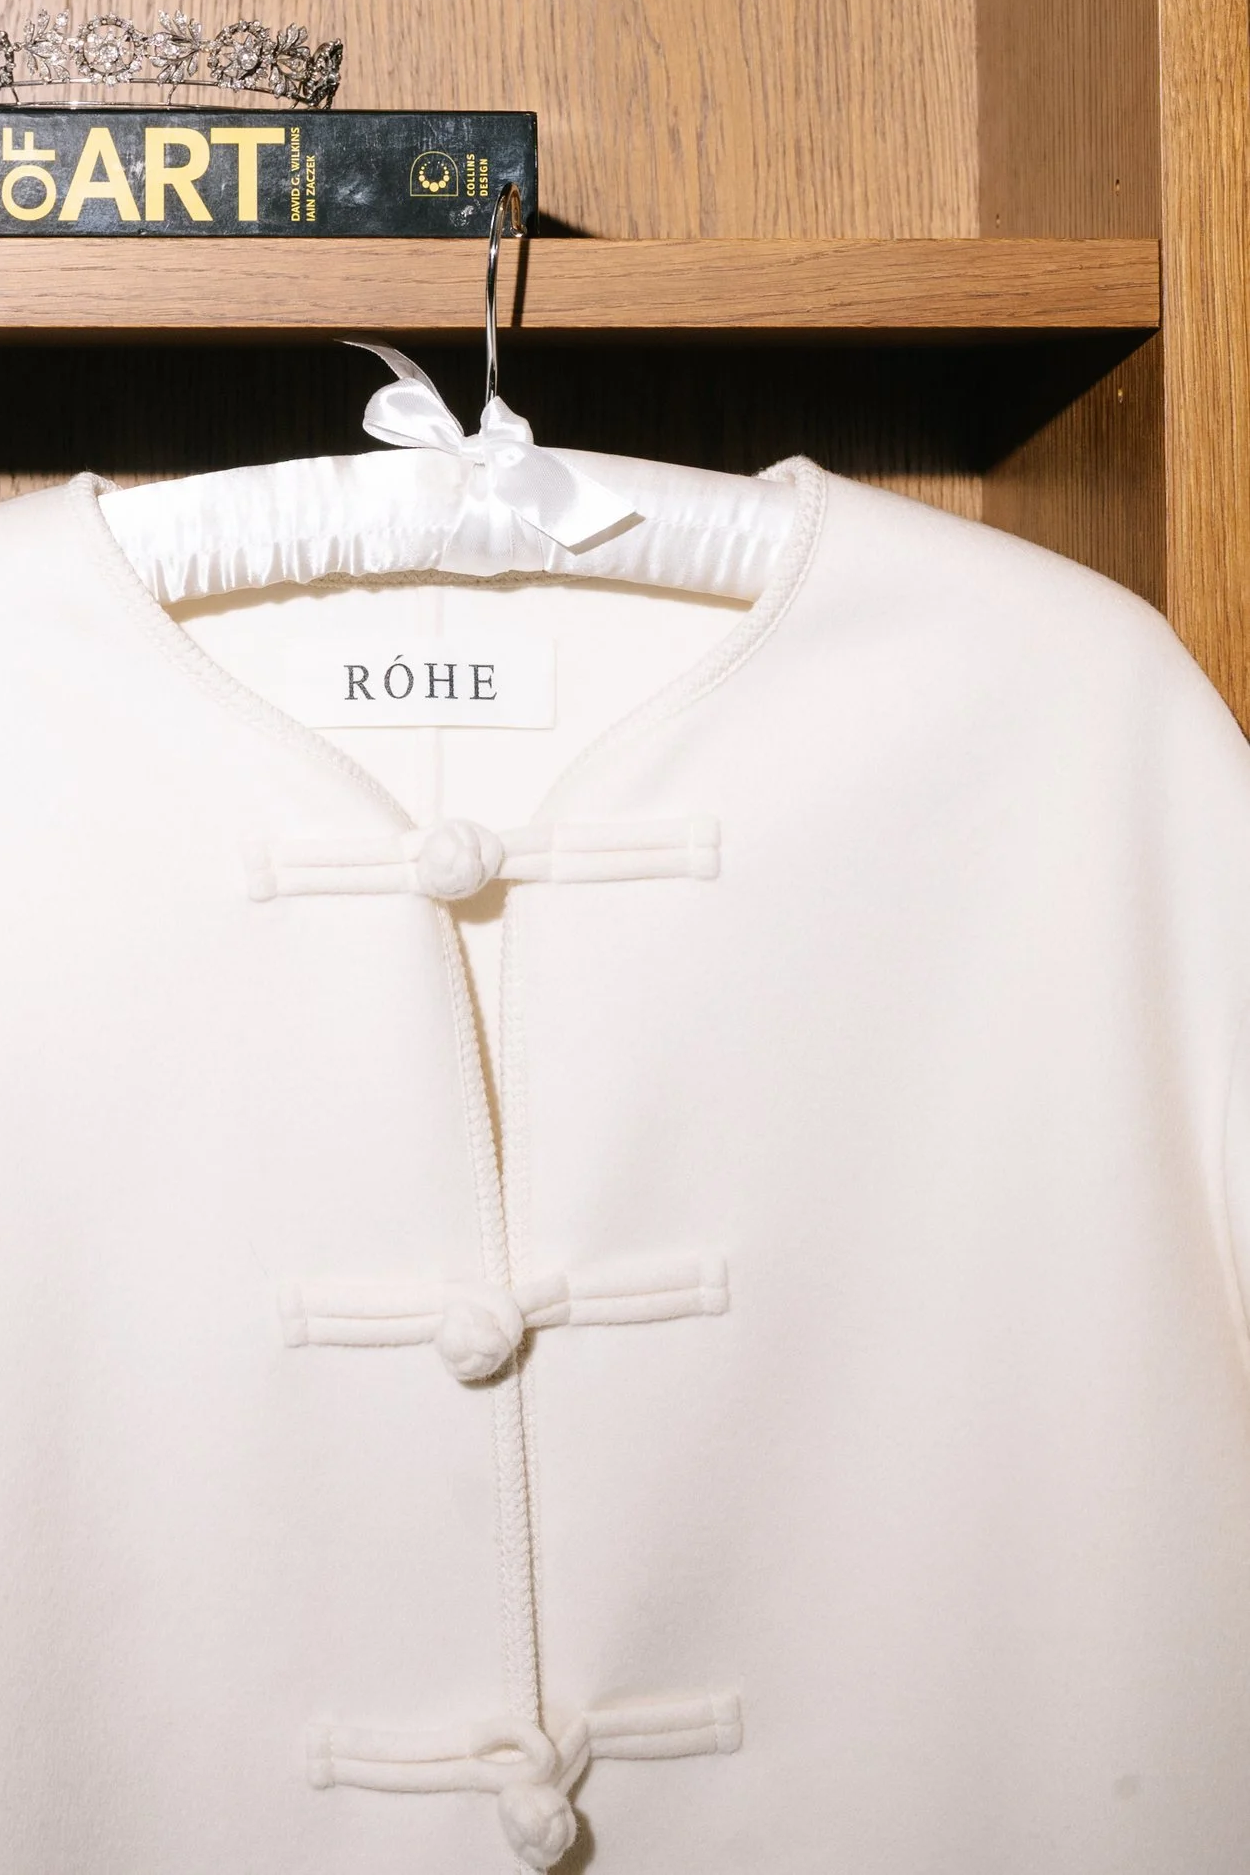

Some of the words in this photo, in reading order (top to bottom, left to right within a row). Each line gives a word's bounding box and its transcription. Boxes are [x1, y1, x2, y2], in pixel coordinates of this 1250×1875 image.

[291, 127, 300, 172] WILKINS
[1, 127, 57, 222] OF
[58, 127, 285, 222] ART
[291, 174, 300, 186] G.
[306, 155, 316, 196] ZACZEK
[466, 153, 475, 196] COLLINS
[479, 158, 488, 196] DESIGN
[291, 188, 300, 222] DAVID
[306, 199, 316, 222] IAIN
[344, 654, 498, 700] RÓHE
